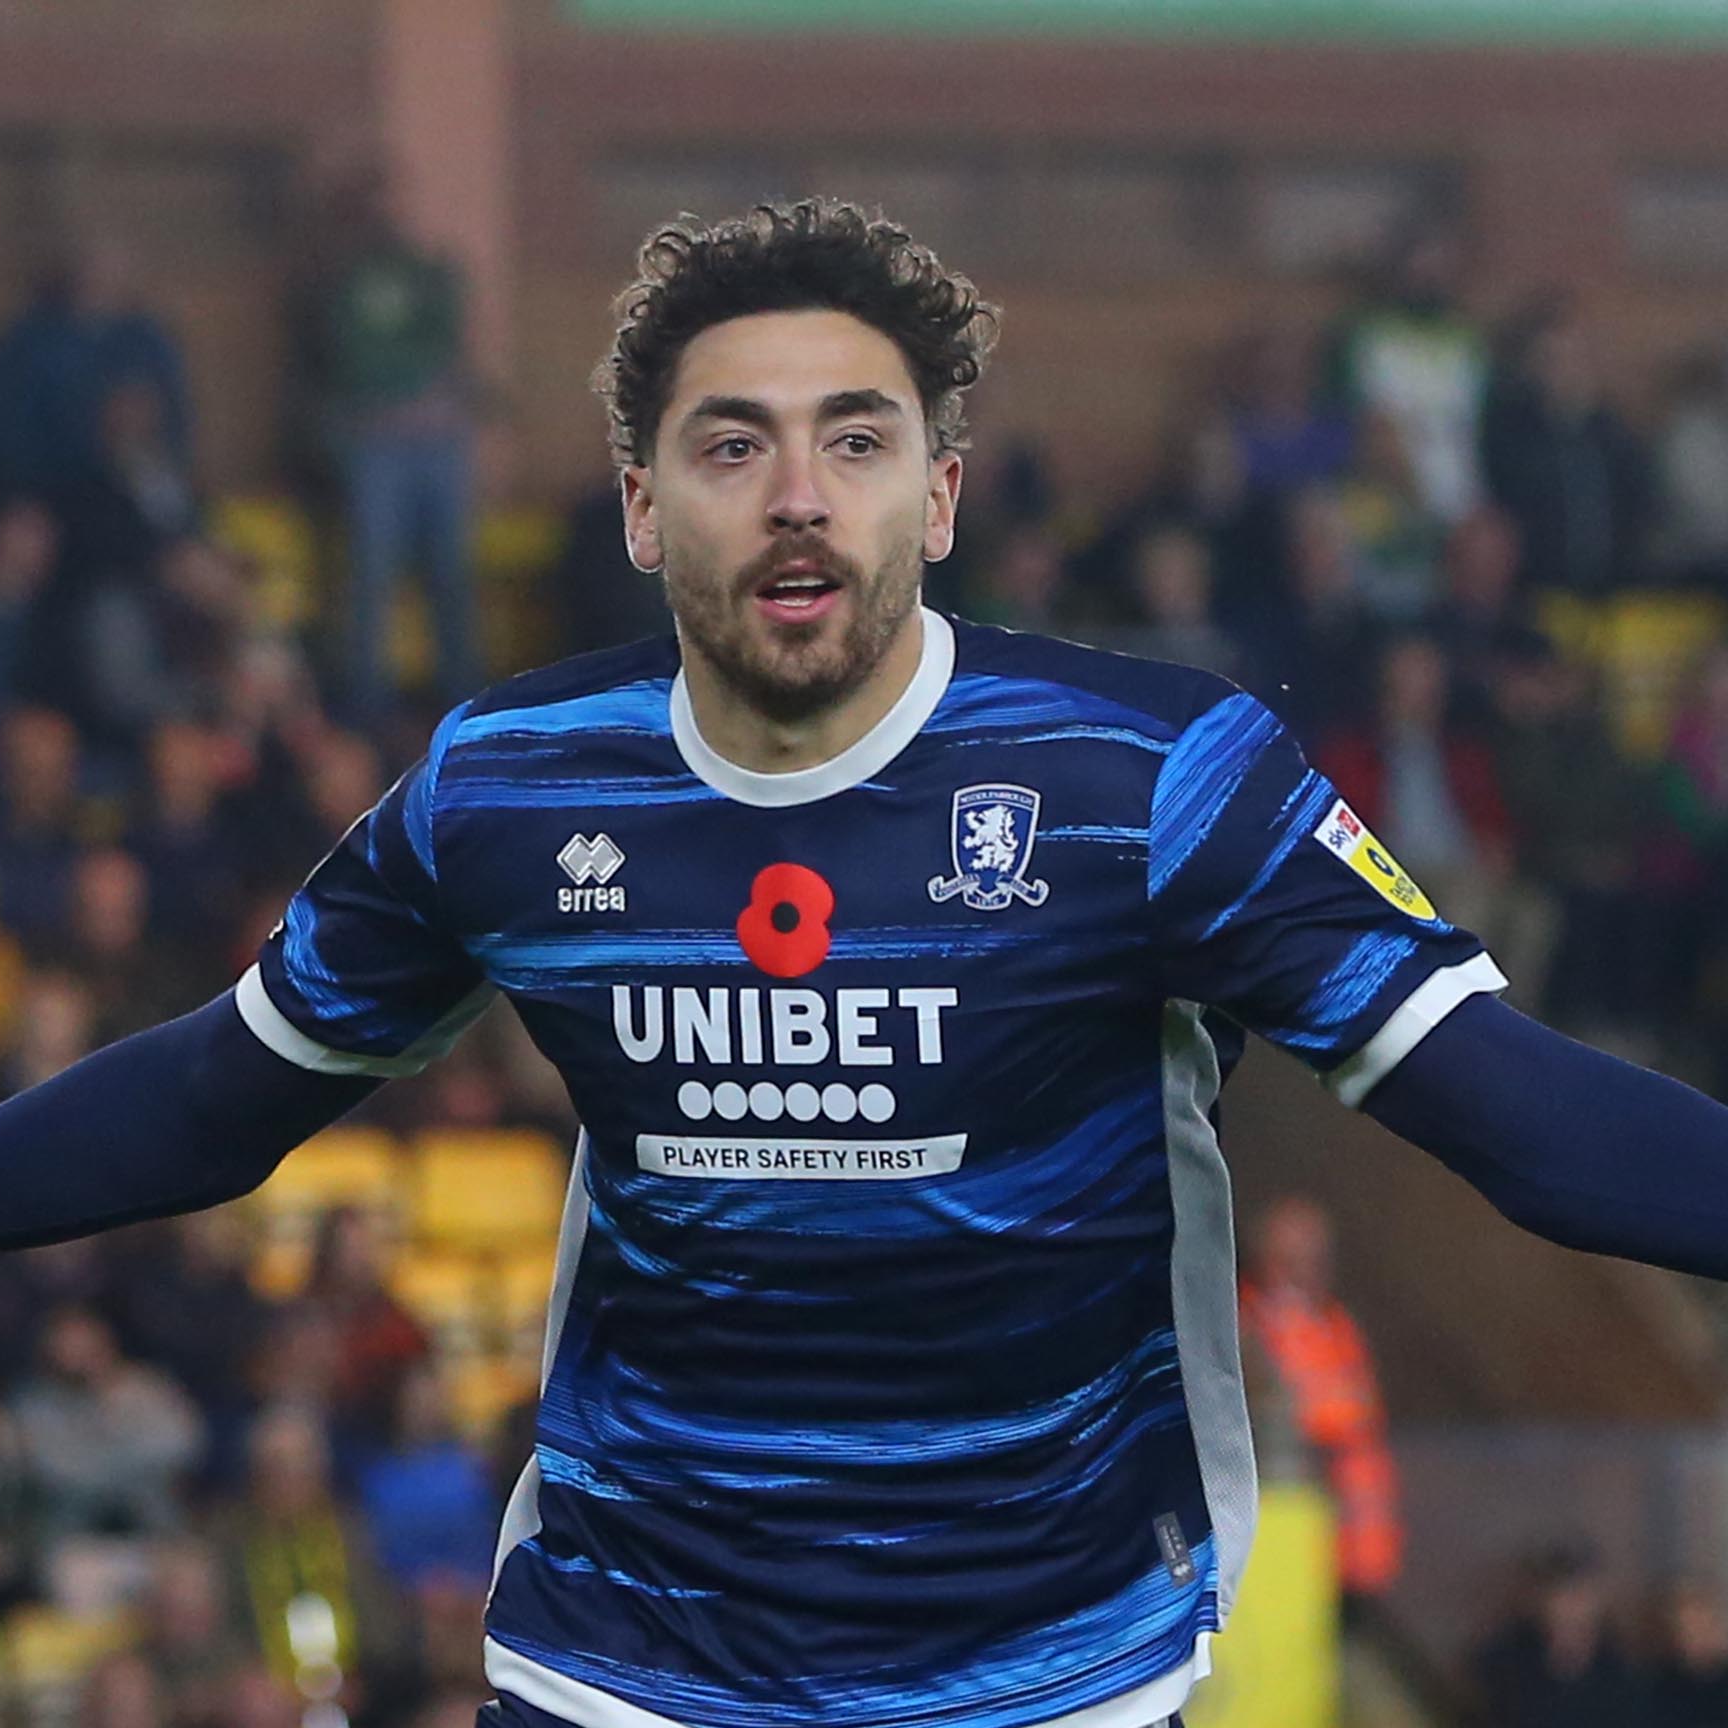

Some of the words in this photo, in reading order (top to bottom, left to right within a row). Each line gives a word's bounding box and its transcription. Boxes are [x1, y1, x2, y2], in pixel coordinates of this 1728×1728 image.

[612, 984, 958, 1065] UNIBET
[663, 1146, 750, 1168] PLAYER
[758, 1149, 848, 1169] SAFETY
[857, 1148, 928, 1169] FIRST
